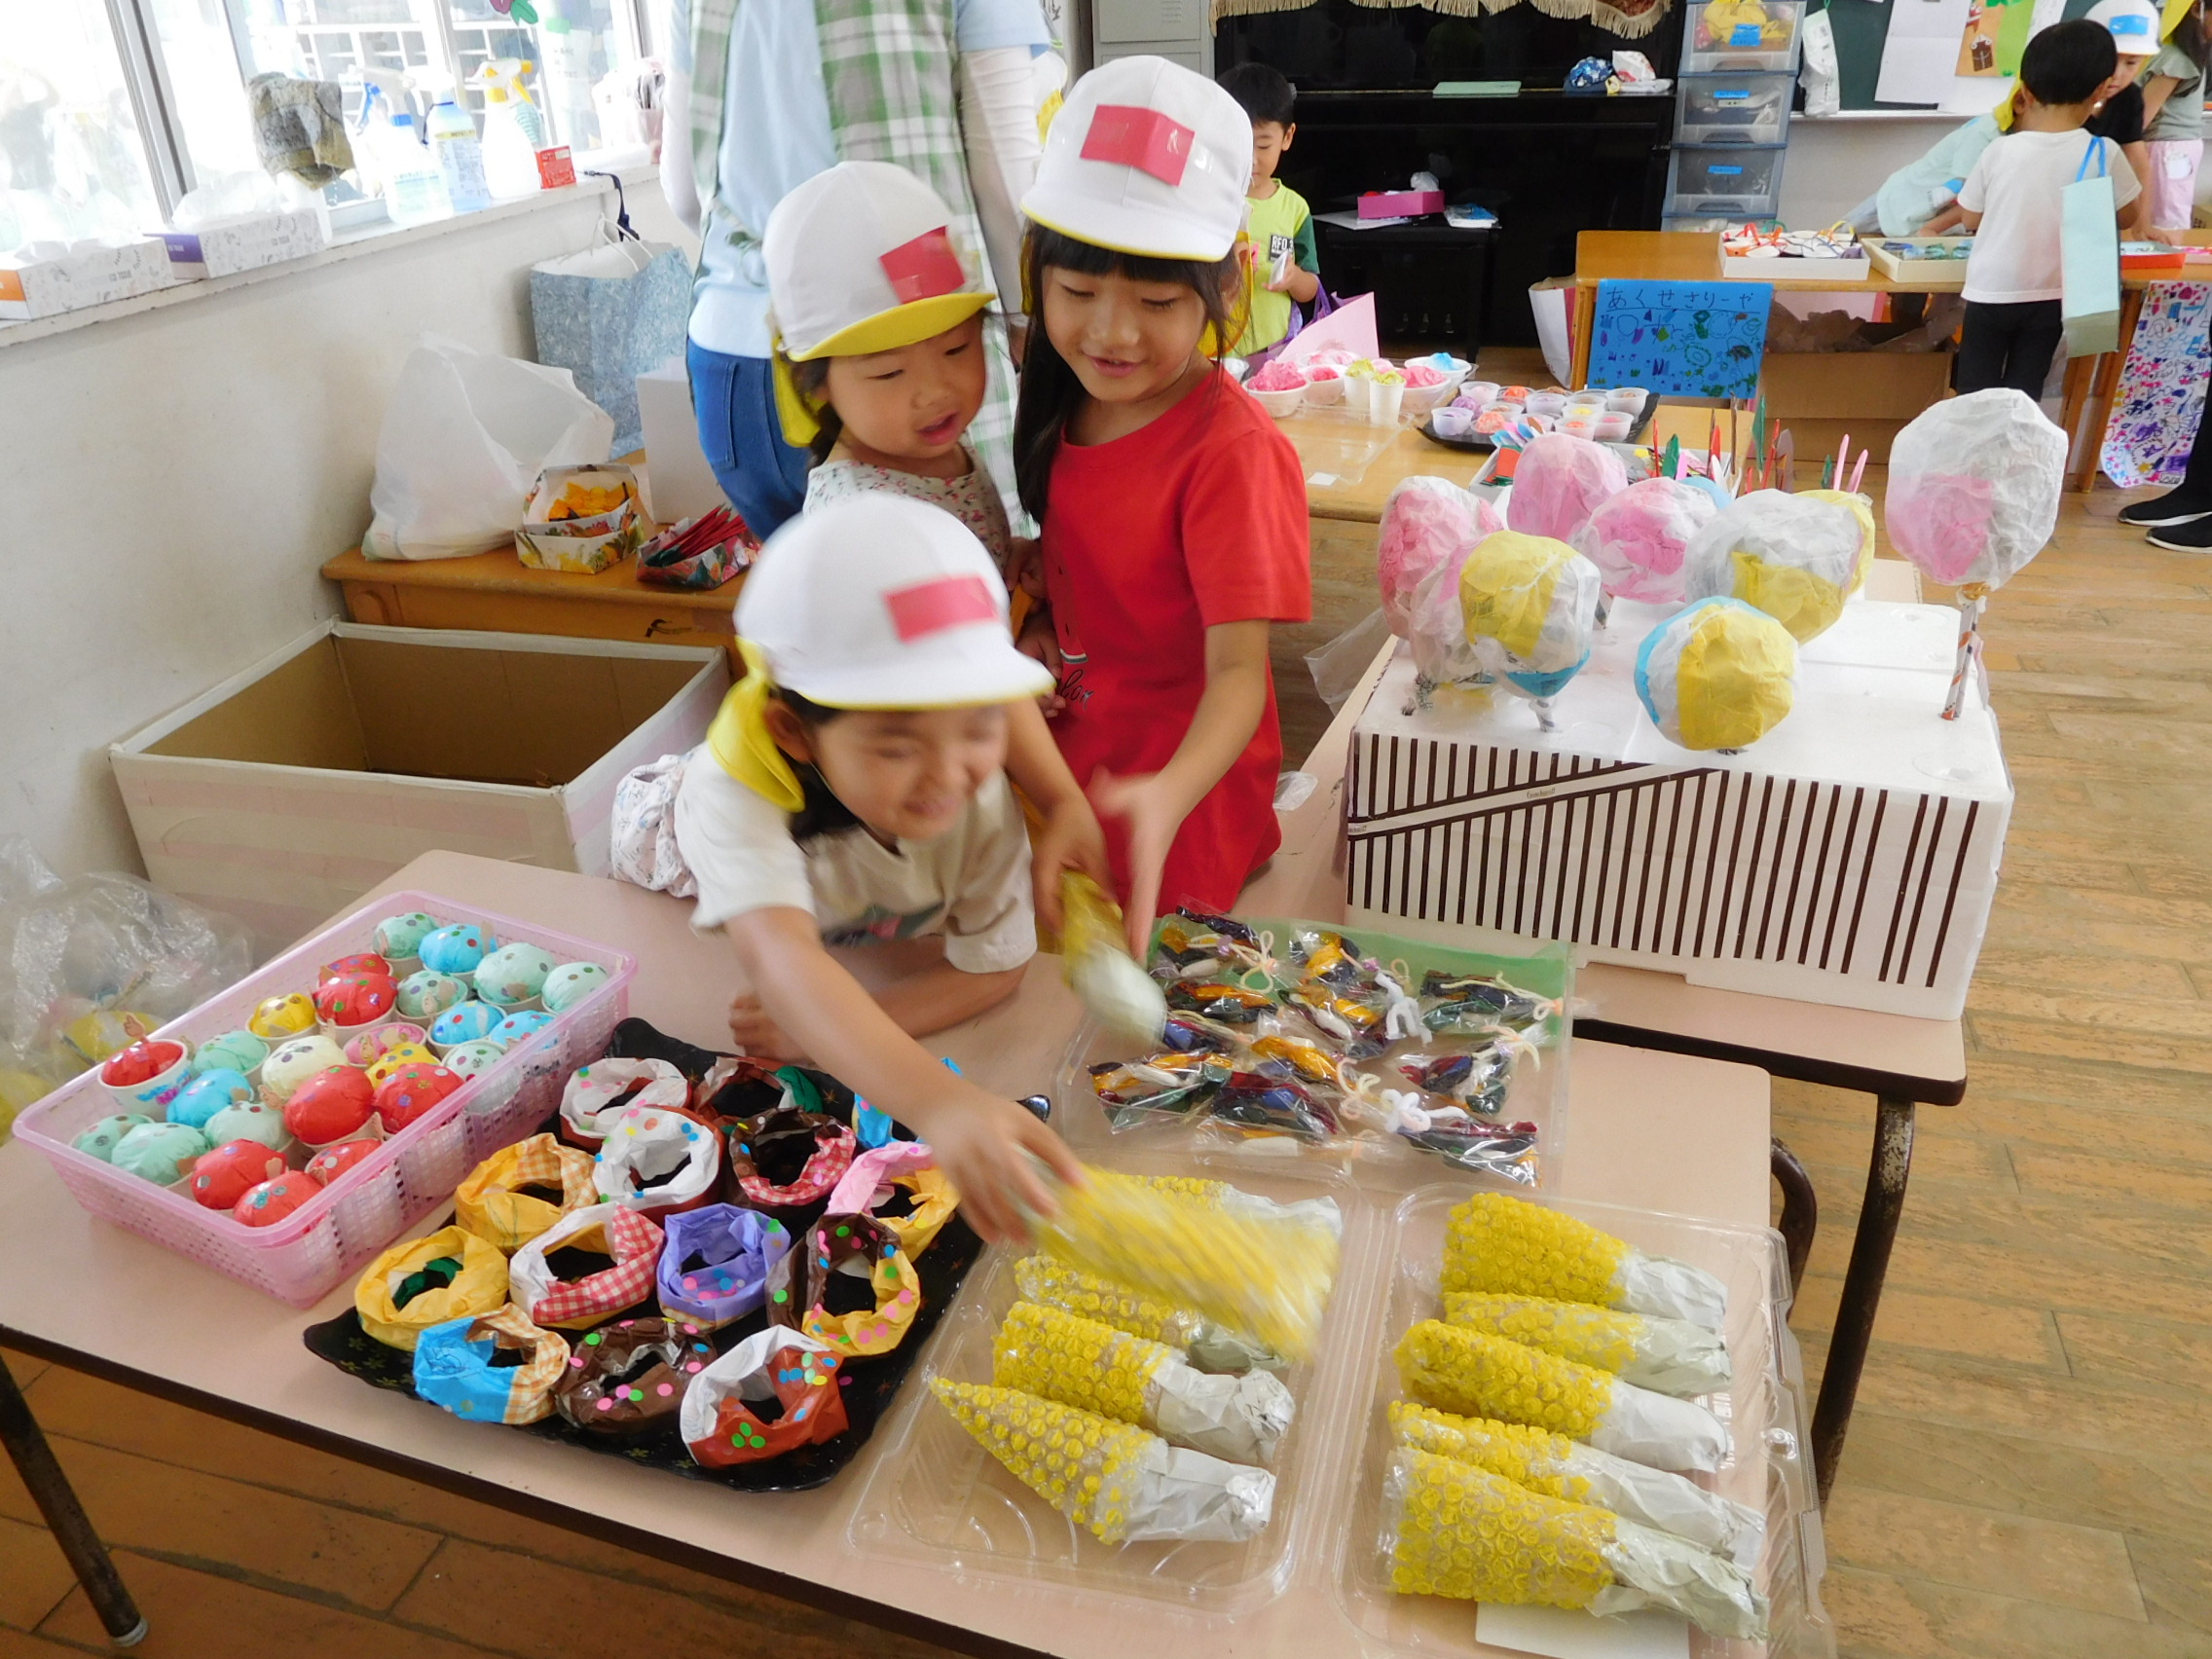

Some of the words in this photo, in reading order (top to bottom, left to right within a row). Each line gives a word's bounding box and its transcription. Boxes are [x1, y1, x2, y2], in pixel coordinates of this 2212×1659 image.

[1606, 286, 1754, 310] あくせさりーや
